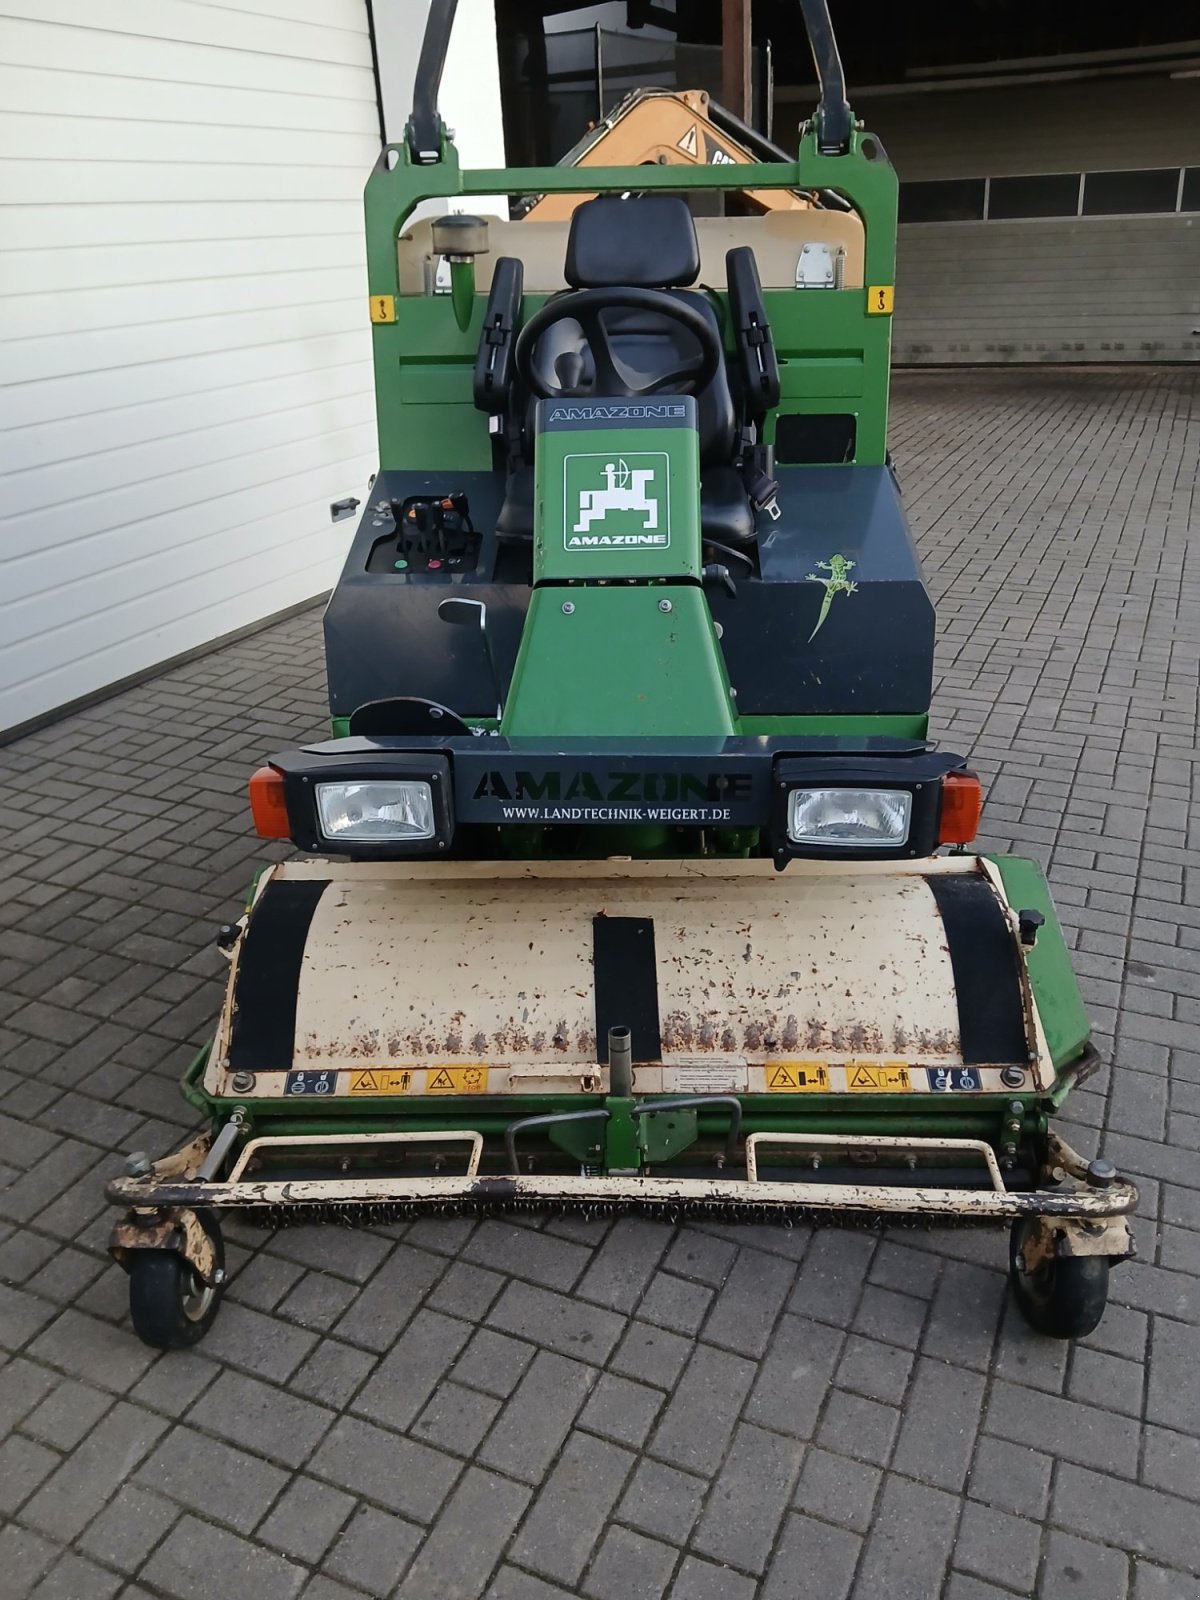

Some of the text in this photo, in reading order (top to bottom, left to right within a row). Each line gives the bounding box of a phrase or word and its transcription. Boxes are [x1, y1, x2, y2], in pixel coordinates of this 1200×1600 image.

[549, 405, 686, 422] AMAZONE
[569, 535, 666, 546] AMAZONE
[472, 771, 753, 802] AMAZONE
[502, 807, 731, 820] WWW.LANDTECHNIK-WEIGERT.DE
